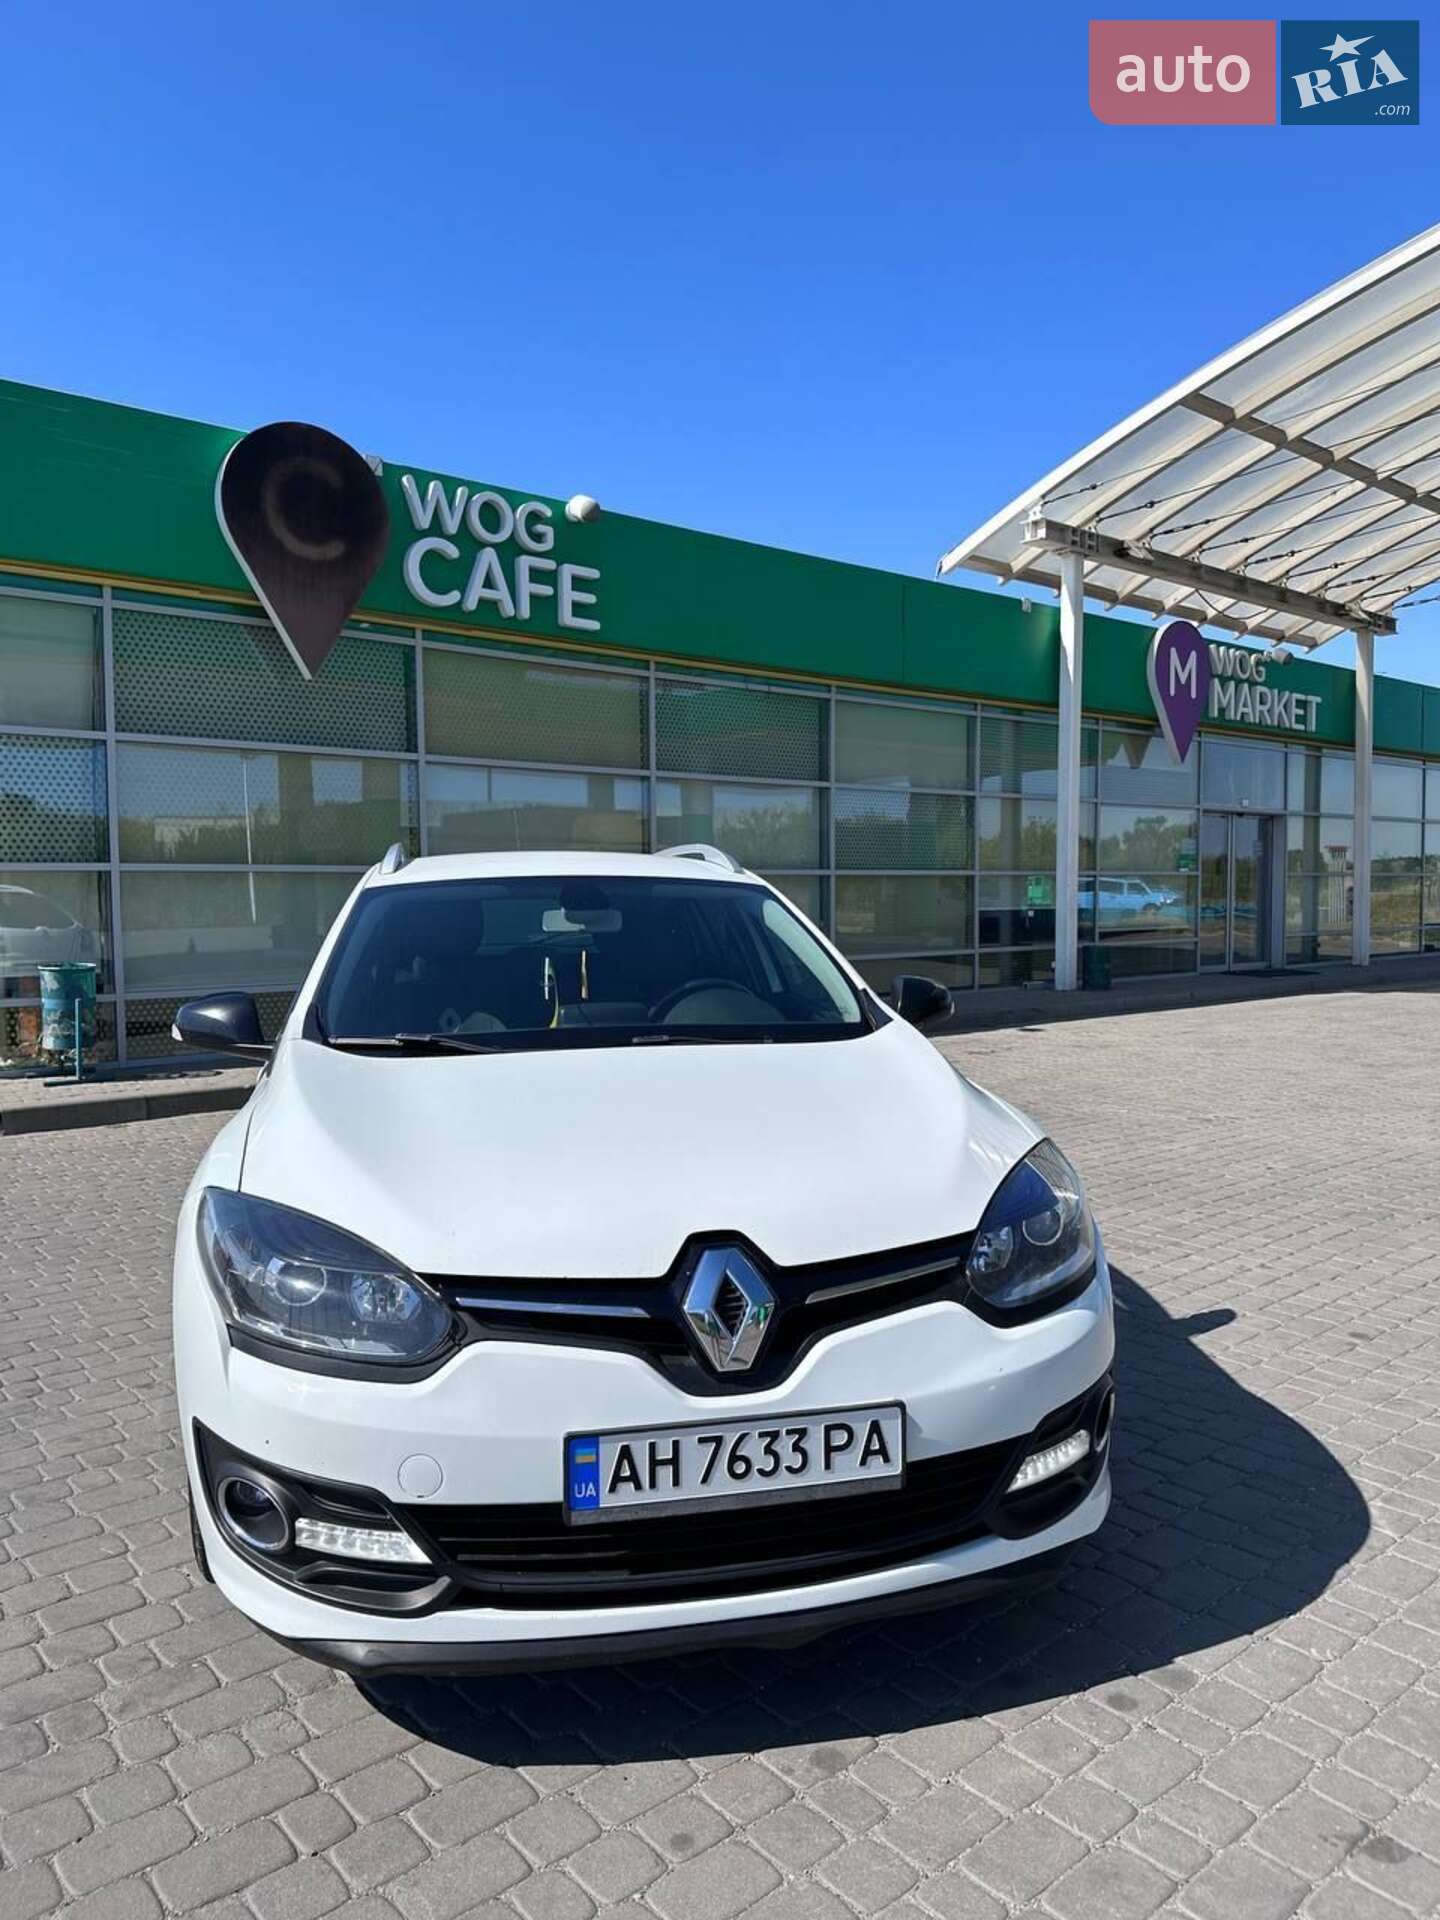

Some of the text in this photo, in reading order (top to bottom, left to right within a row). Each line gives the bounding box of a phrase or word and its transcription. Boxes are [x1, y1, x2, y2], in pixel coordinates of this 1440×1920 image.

[262, 457, 346, 561] C
[401, 474, 555, 553] WOG
[403, 537, 601, 631] CAFE
[1169, 647, 1197, 699] M
[1209, 644, 1266, 682] WOG
[1208, 678, 1322, 732] MARKET
[608, 1419, 891, 1493] AH 7633 PA
[574, 1482, 597, 1498] UA
